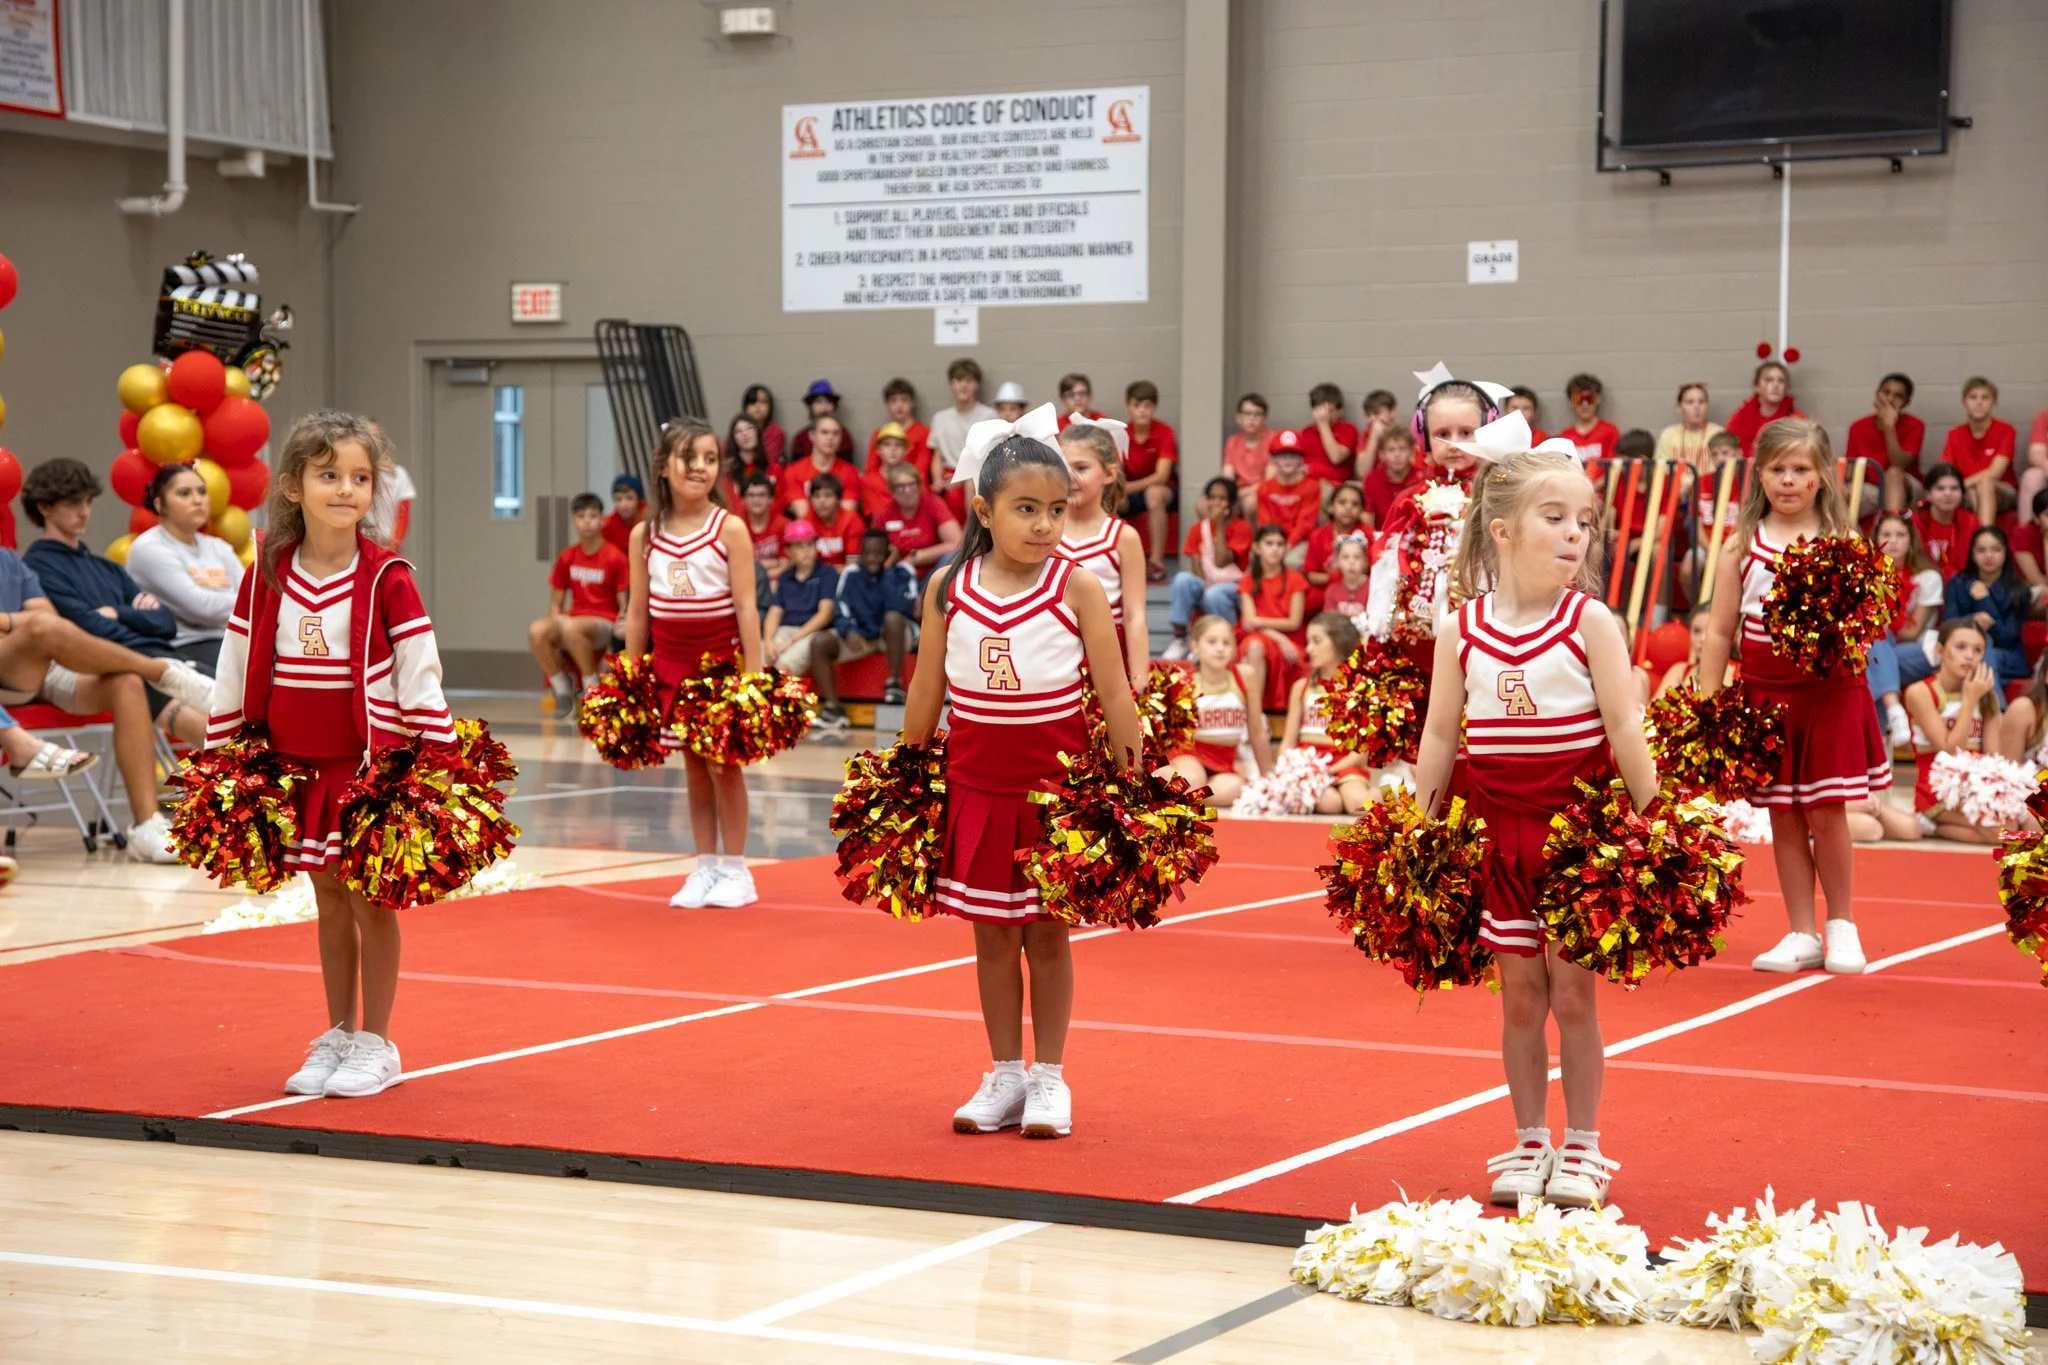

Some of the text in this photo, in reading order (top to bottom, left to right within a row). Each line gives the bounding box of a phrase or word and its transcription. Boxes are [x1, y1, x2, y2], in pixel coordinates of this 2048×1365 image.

[832, 94, 1096, 132] ATHLETICS CODE OF CONDUCT
[844, 209, 889, 223] SUPPORT
[892, 208, 909, 222] ALL
[962, 204, 1009, 219] COACHES
[1013, 203, 1033, 217] AND
[1036, 200, 1089, 216] OFFICIALS
[846, 219, 1076, 240] AND TRUST THEIR JUDGEMENT AND INTEGRITY
[808, 251, 840, 266] CHEER
[843, 248, 914, 264] PARTICIPANTS
[918, 248, 927, 262] IN
[931, 248, 937, 261] A
[940, 246, 984, 261] POSITIVE
[988, 245, 1008, 259] AND
[1011, 242, 1084, 258] ENCOURAGING
[1087, 240, 1134, 256] MANNER
[871, 272, 916, 287] RESPECT
[919, 271, 936, 285] THE
[939, 270, 987, 285] PROPERTY
[990, 270, 1000, 283] OF
[1004, 269, 1022, 282] THE
[520, 289, 551, 315] EXIT
[843, 290, 862, 304] AND
[864, 290, 888, 303] HELP
[890, 289, 930, 302] PROVIDE
[942, 287, 966, 301] SAFE
[969, 286, 988, 300] AND
[991, 285, 1009, 299] FUN
[1012, 284, 1082, 298] ENVIRONMENT
[668, 561, 696, 596] CA
[299, 615, 329, 656] CA
[979, 637, 1021, 691] CA
[1498, 670, 1537, 716] CA
